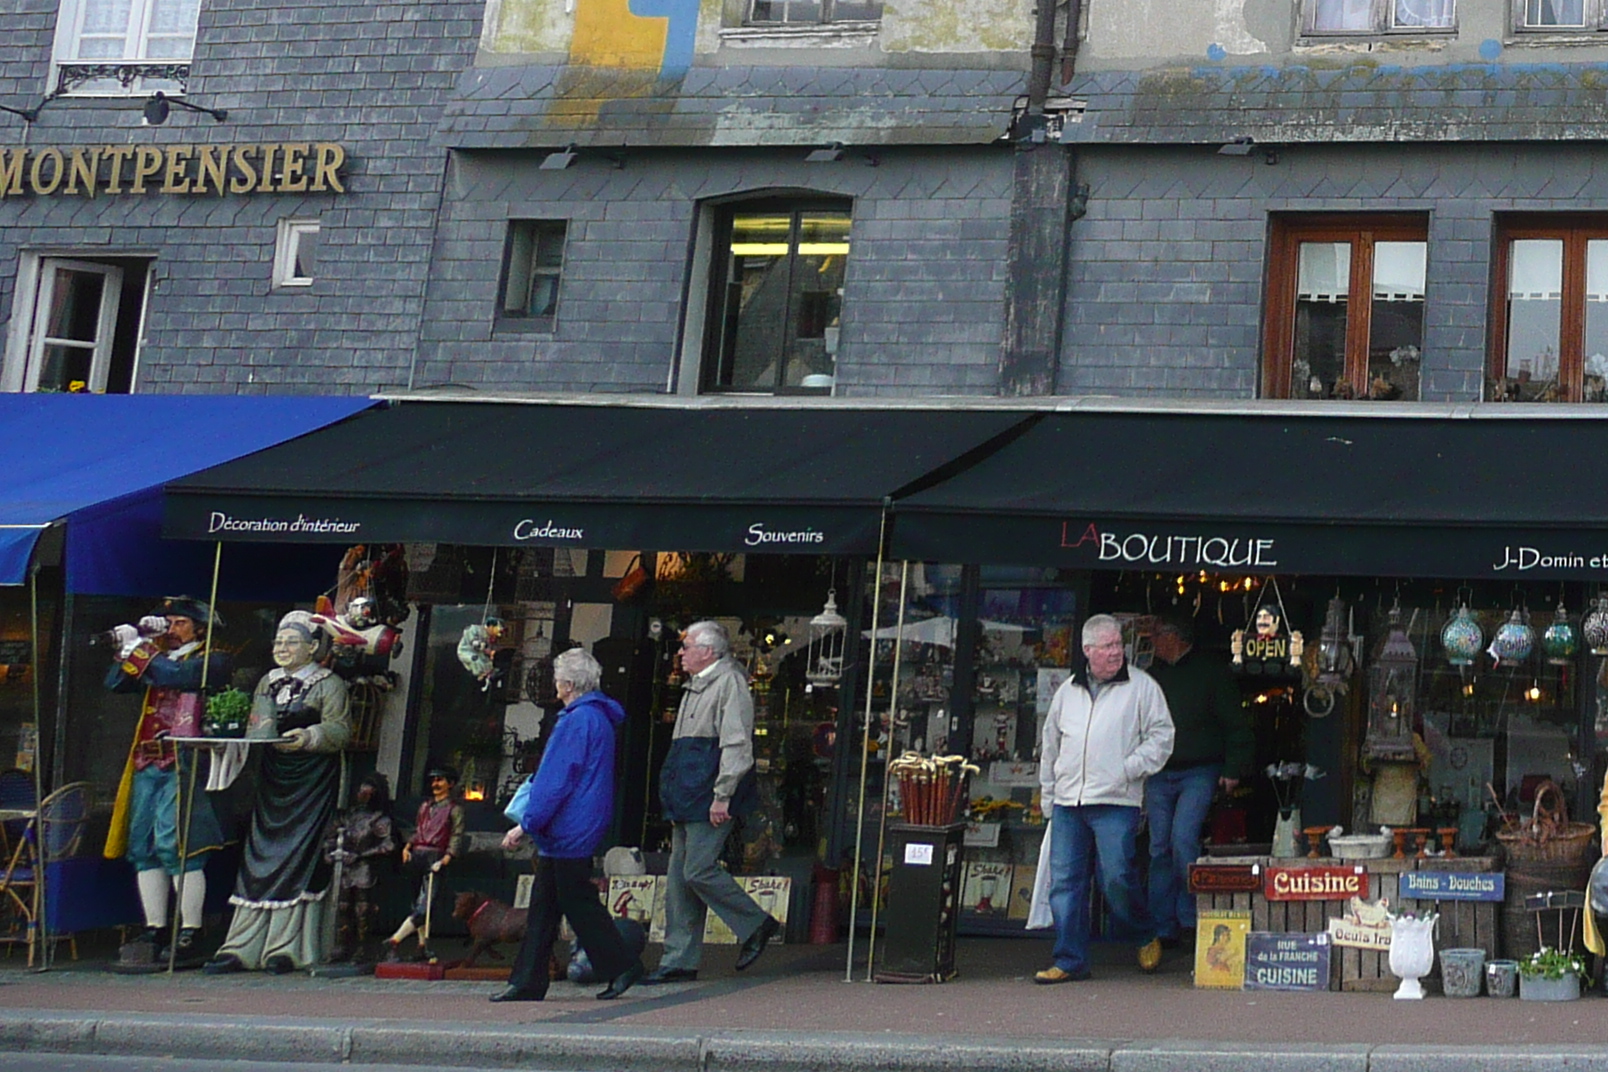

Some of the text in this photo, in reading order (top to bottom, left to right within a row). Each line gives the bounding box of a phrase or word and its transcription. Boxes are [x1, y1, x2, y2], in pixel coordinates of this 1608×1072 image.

[0, 142, 345, 199] MONTPENSIER
[208, 511, 361, 534] Décoration d'intérieur
[514, 519, 584, 541] Cadeaux
[745, 523, 824, 546] Souvenirs
[1061, 521, 1100, 548] LA
[1098, 532, 1277, 567] BOUTIQUE
[1493, 546, 1584, 571] J-Domin
[1246, 638, 1286, 659] OPEN
[1274, 872, 1360, 895] Cuisine
[1408, 873, 1439, 890] Bains
[1449, 874, 1495, 892] Douches
[1277, 940, 1297, 950] RUE
[1257, 951, 1318, 963] de la FRANCHE
[1257, 967, 1318, 985] CUISINE
